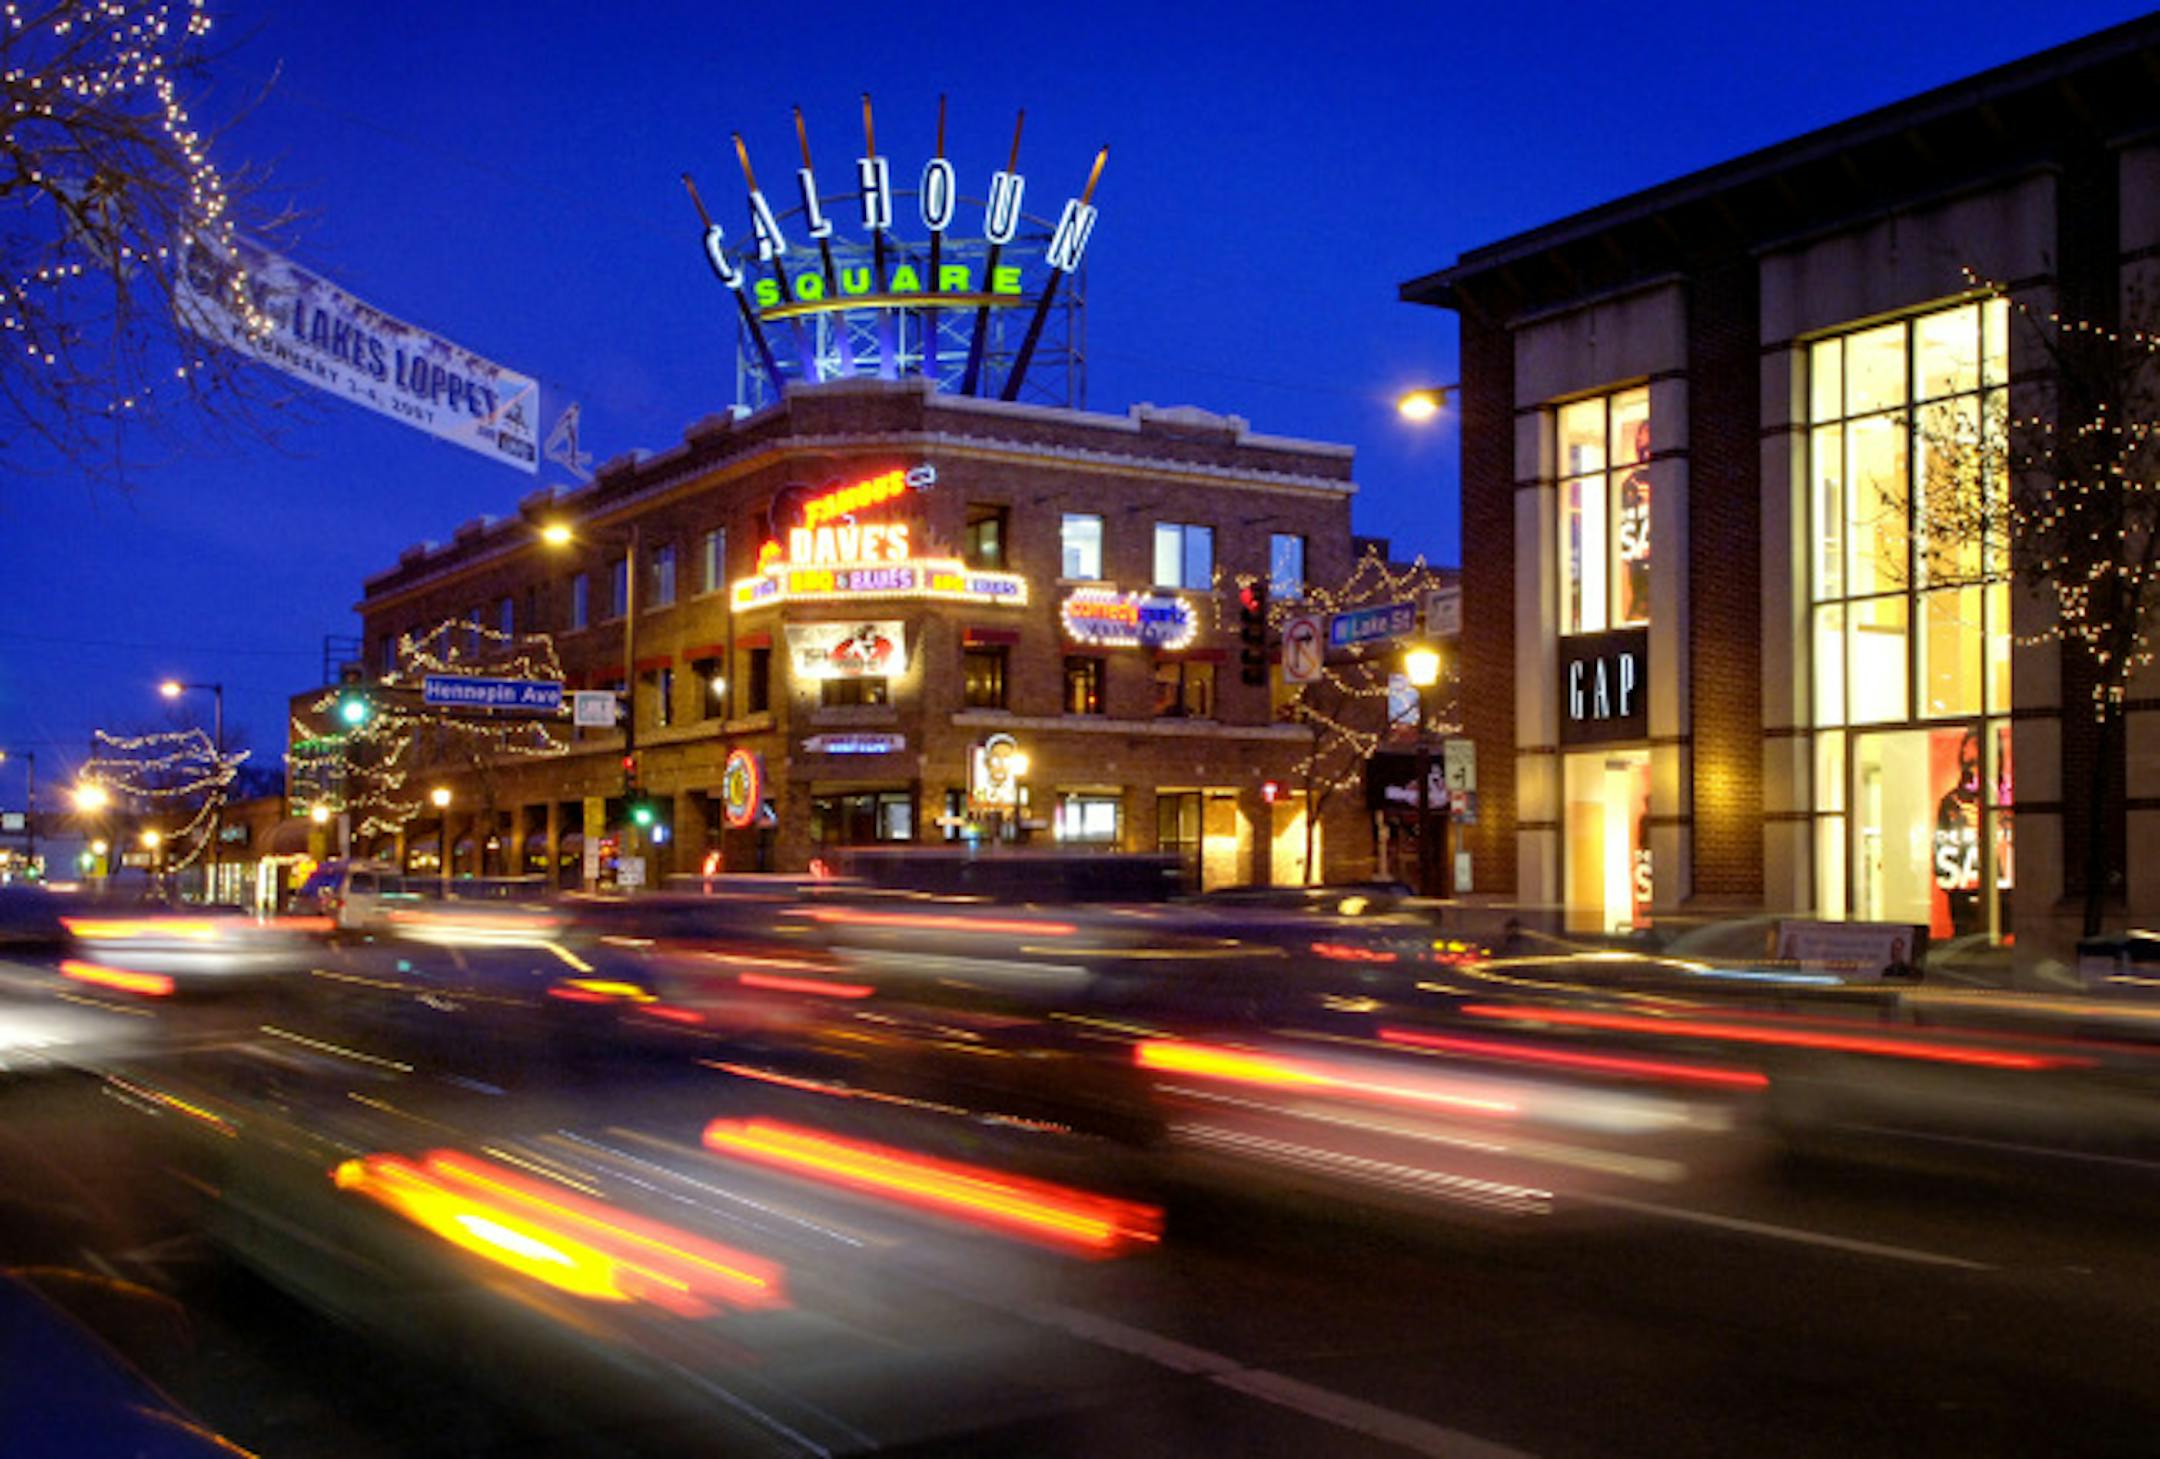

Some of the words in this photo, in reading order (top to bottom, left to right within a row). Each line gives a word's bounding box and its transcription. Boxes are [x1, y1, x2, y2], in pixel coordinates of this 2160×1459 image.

[703, 156, 1097, 288] CALHOUN
[755, 264, 1022, 307] SQUARE
[231, 323, 340, 385] FBRUARY
[293, 298, 388, 383] LAKES
[395, 348, 500, 420] LOPPET
[789, 523, 909, 564] DAVE'S
[851, 569, 913, 591] BLUES
[1353, 616, 1389, 640] Lake
[1391, 609, 1411, 631] St
[426, 679, 517, 706] Hennepin
[520, 685, 560, 705] Ave
[1569, 652, 1635, 721] GAP
